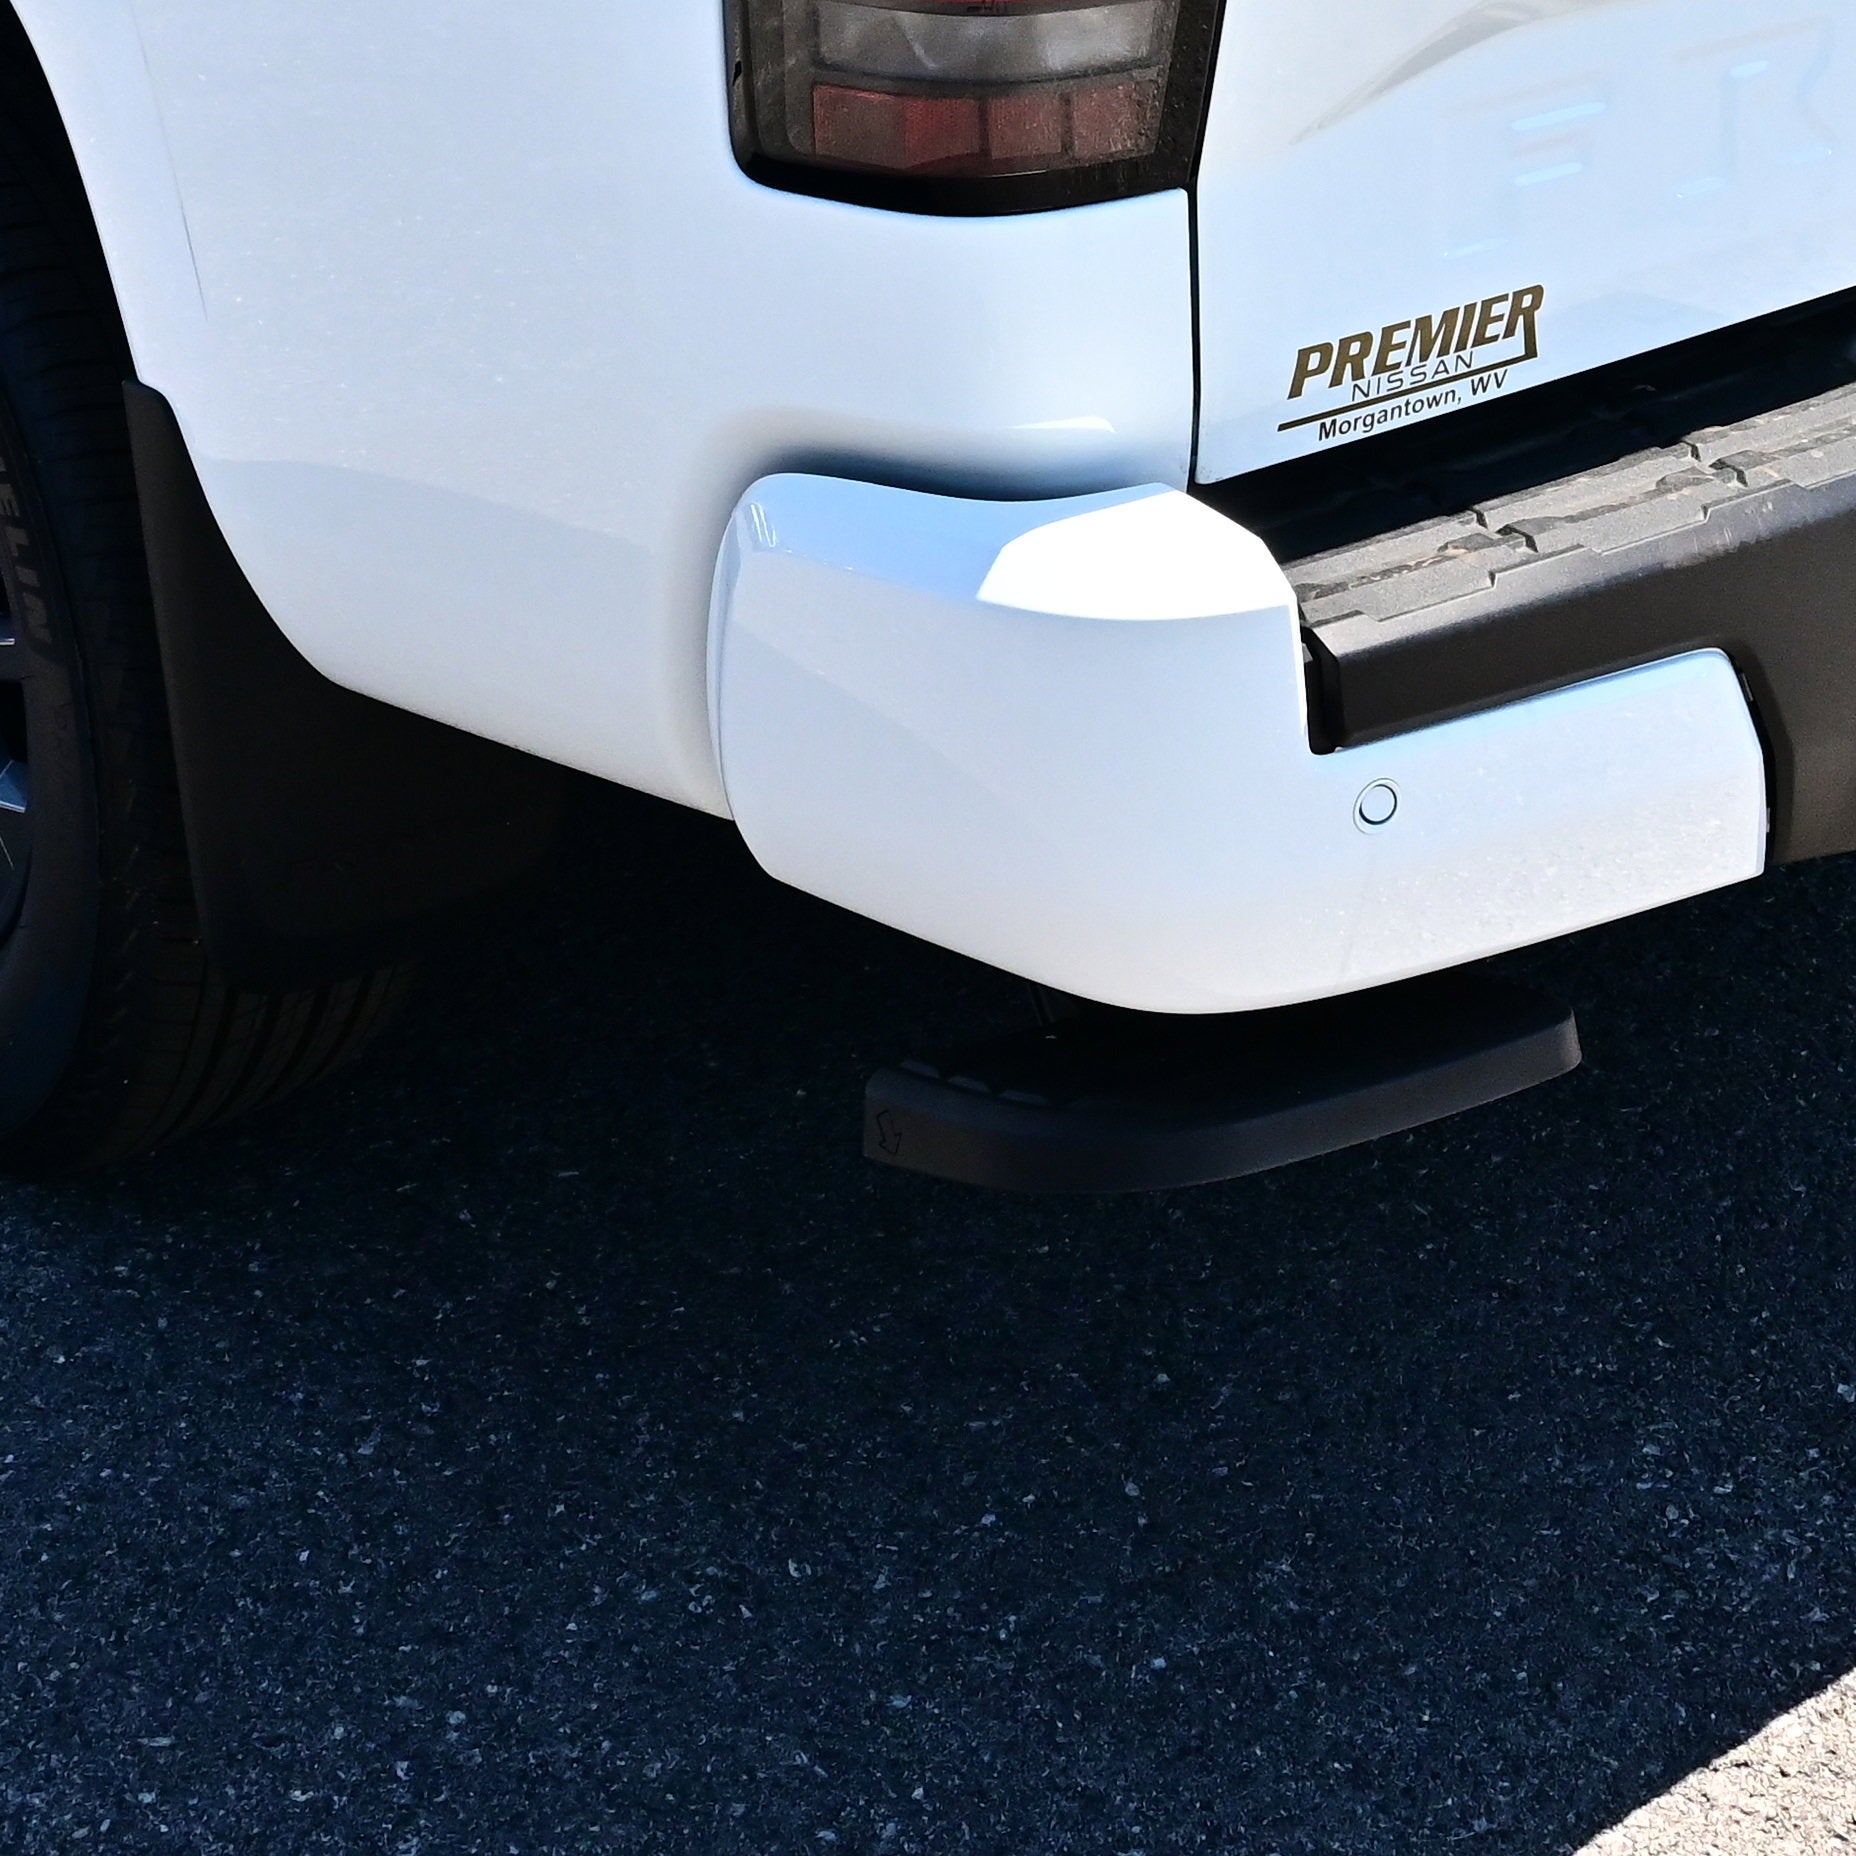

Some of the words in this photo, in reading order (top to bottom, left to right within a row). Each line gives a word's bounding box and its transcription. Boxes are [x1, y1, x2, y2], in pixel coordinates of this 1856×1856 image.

[1286, 284, 1545, 401] PREMIER
[1350, 350, 1474, 402] NISSAN
[1317, 387, 1462, 442] Morgantown,
[1469, 368, 1509, 396] WV
